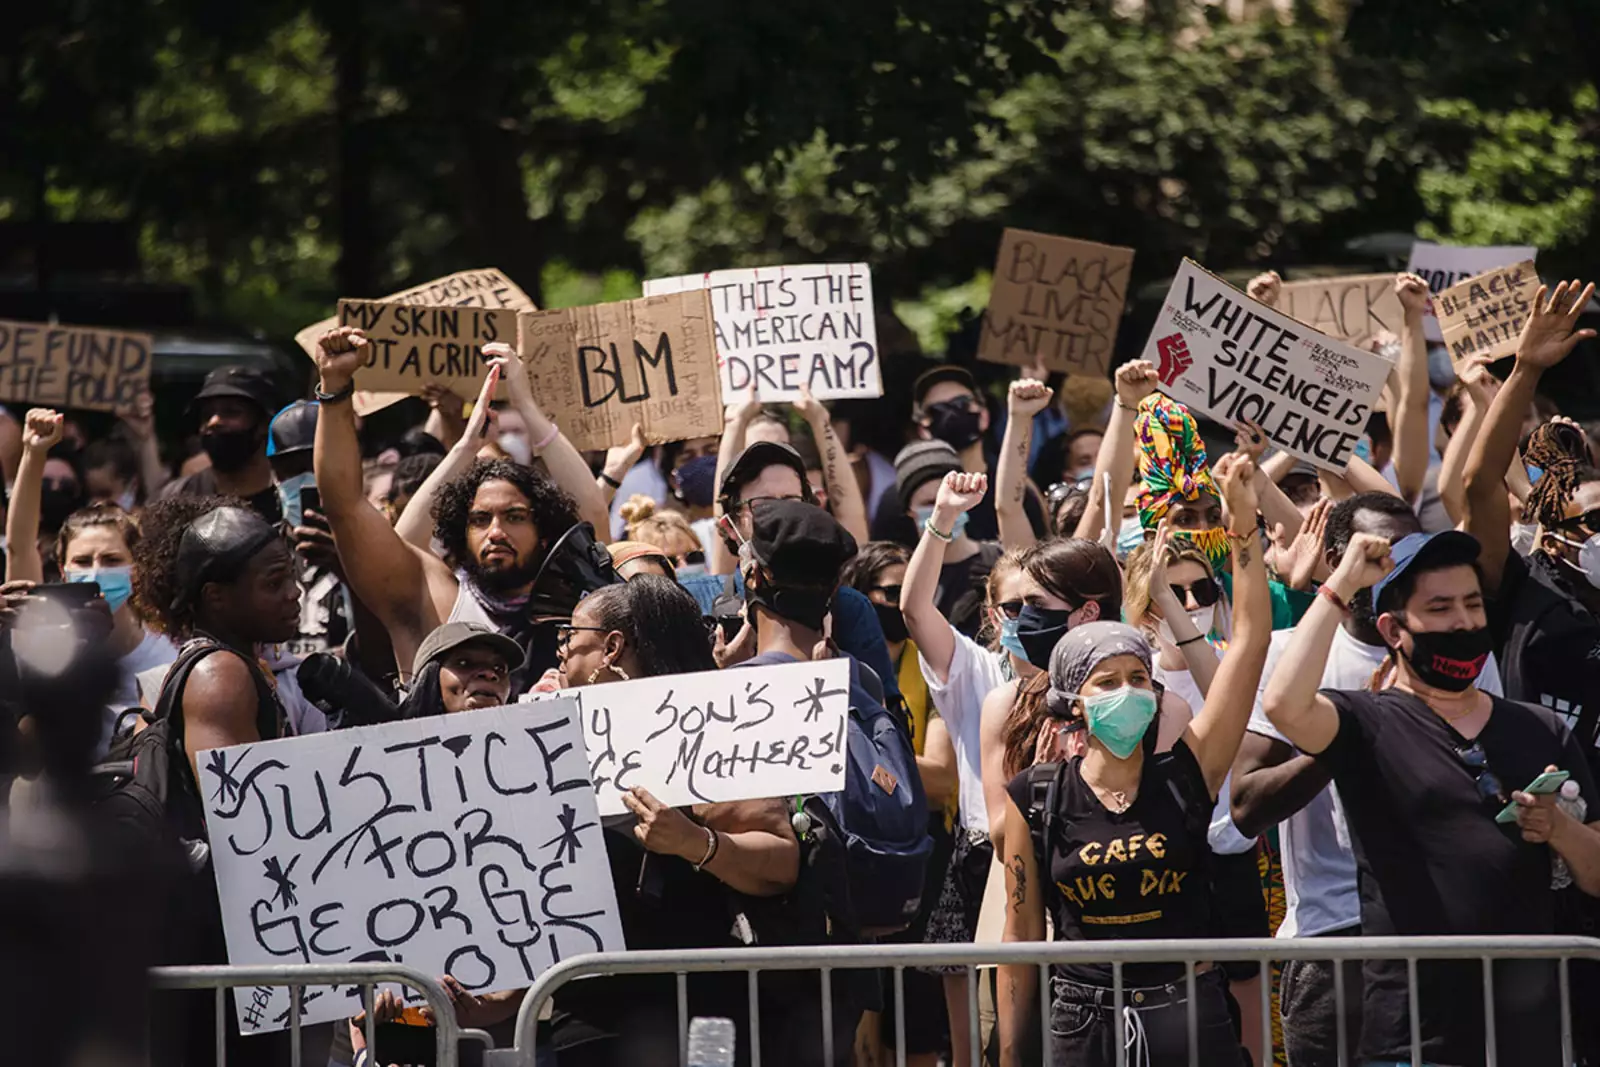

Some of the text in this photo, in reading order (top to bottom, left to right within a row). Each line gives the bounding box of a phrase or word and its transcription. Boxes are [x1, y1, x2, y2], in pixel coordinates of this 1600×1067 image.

[711, 274, 864, 313] THIS THE
[1006, 240, 1128, 301] BLACK
[1441, 269, 1527, 317] BLACK
[342, 303, 498, 342] MY SKIN IS
[714, 311, 862, 351] AMERICAN
[1019, 285, 1111, 333] LIVES
[1185, 276, 1300, 365] WHITE
[1464, 291, 1529, 329] LIVES
[365, 338, 507, 380] OT A CRIM
[982, 311, 1105, 376] MATTER
[1451, 313, 1532, 360] MATTE
[577, 331, 679, 409] BLM
[728, 341, 874, 391] DREAM?
[1213, 340, 1369, 426] SILENCE IS
[1208, 366, 1360, 468] VIOLENCE
[213, 717, 592, 856] JUSTICE
[311, 804, 538, 886] FOR
[1079, 832, 1168, 866] CAFE
[1140, 868, 1188, 897] DIX
[251, 860, 607, 964] GEORGE
